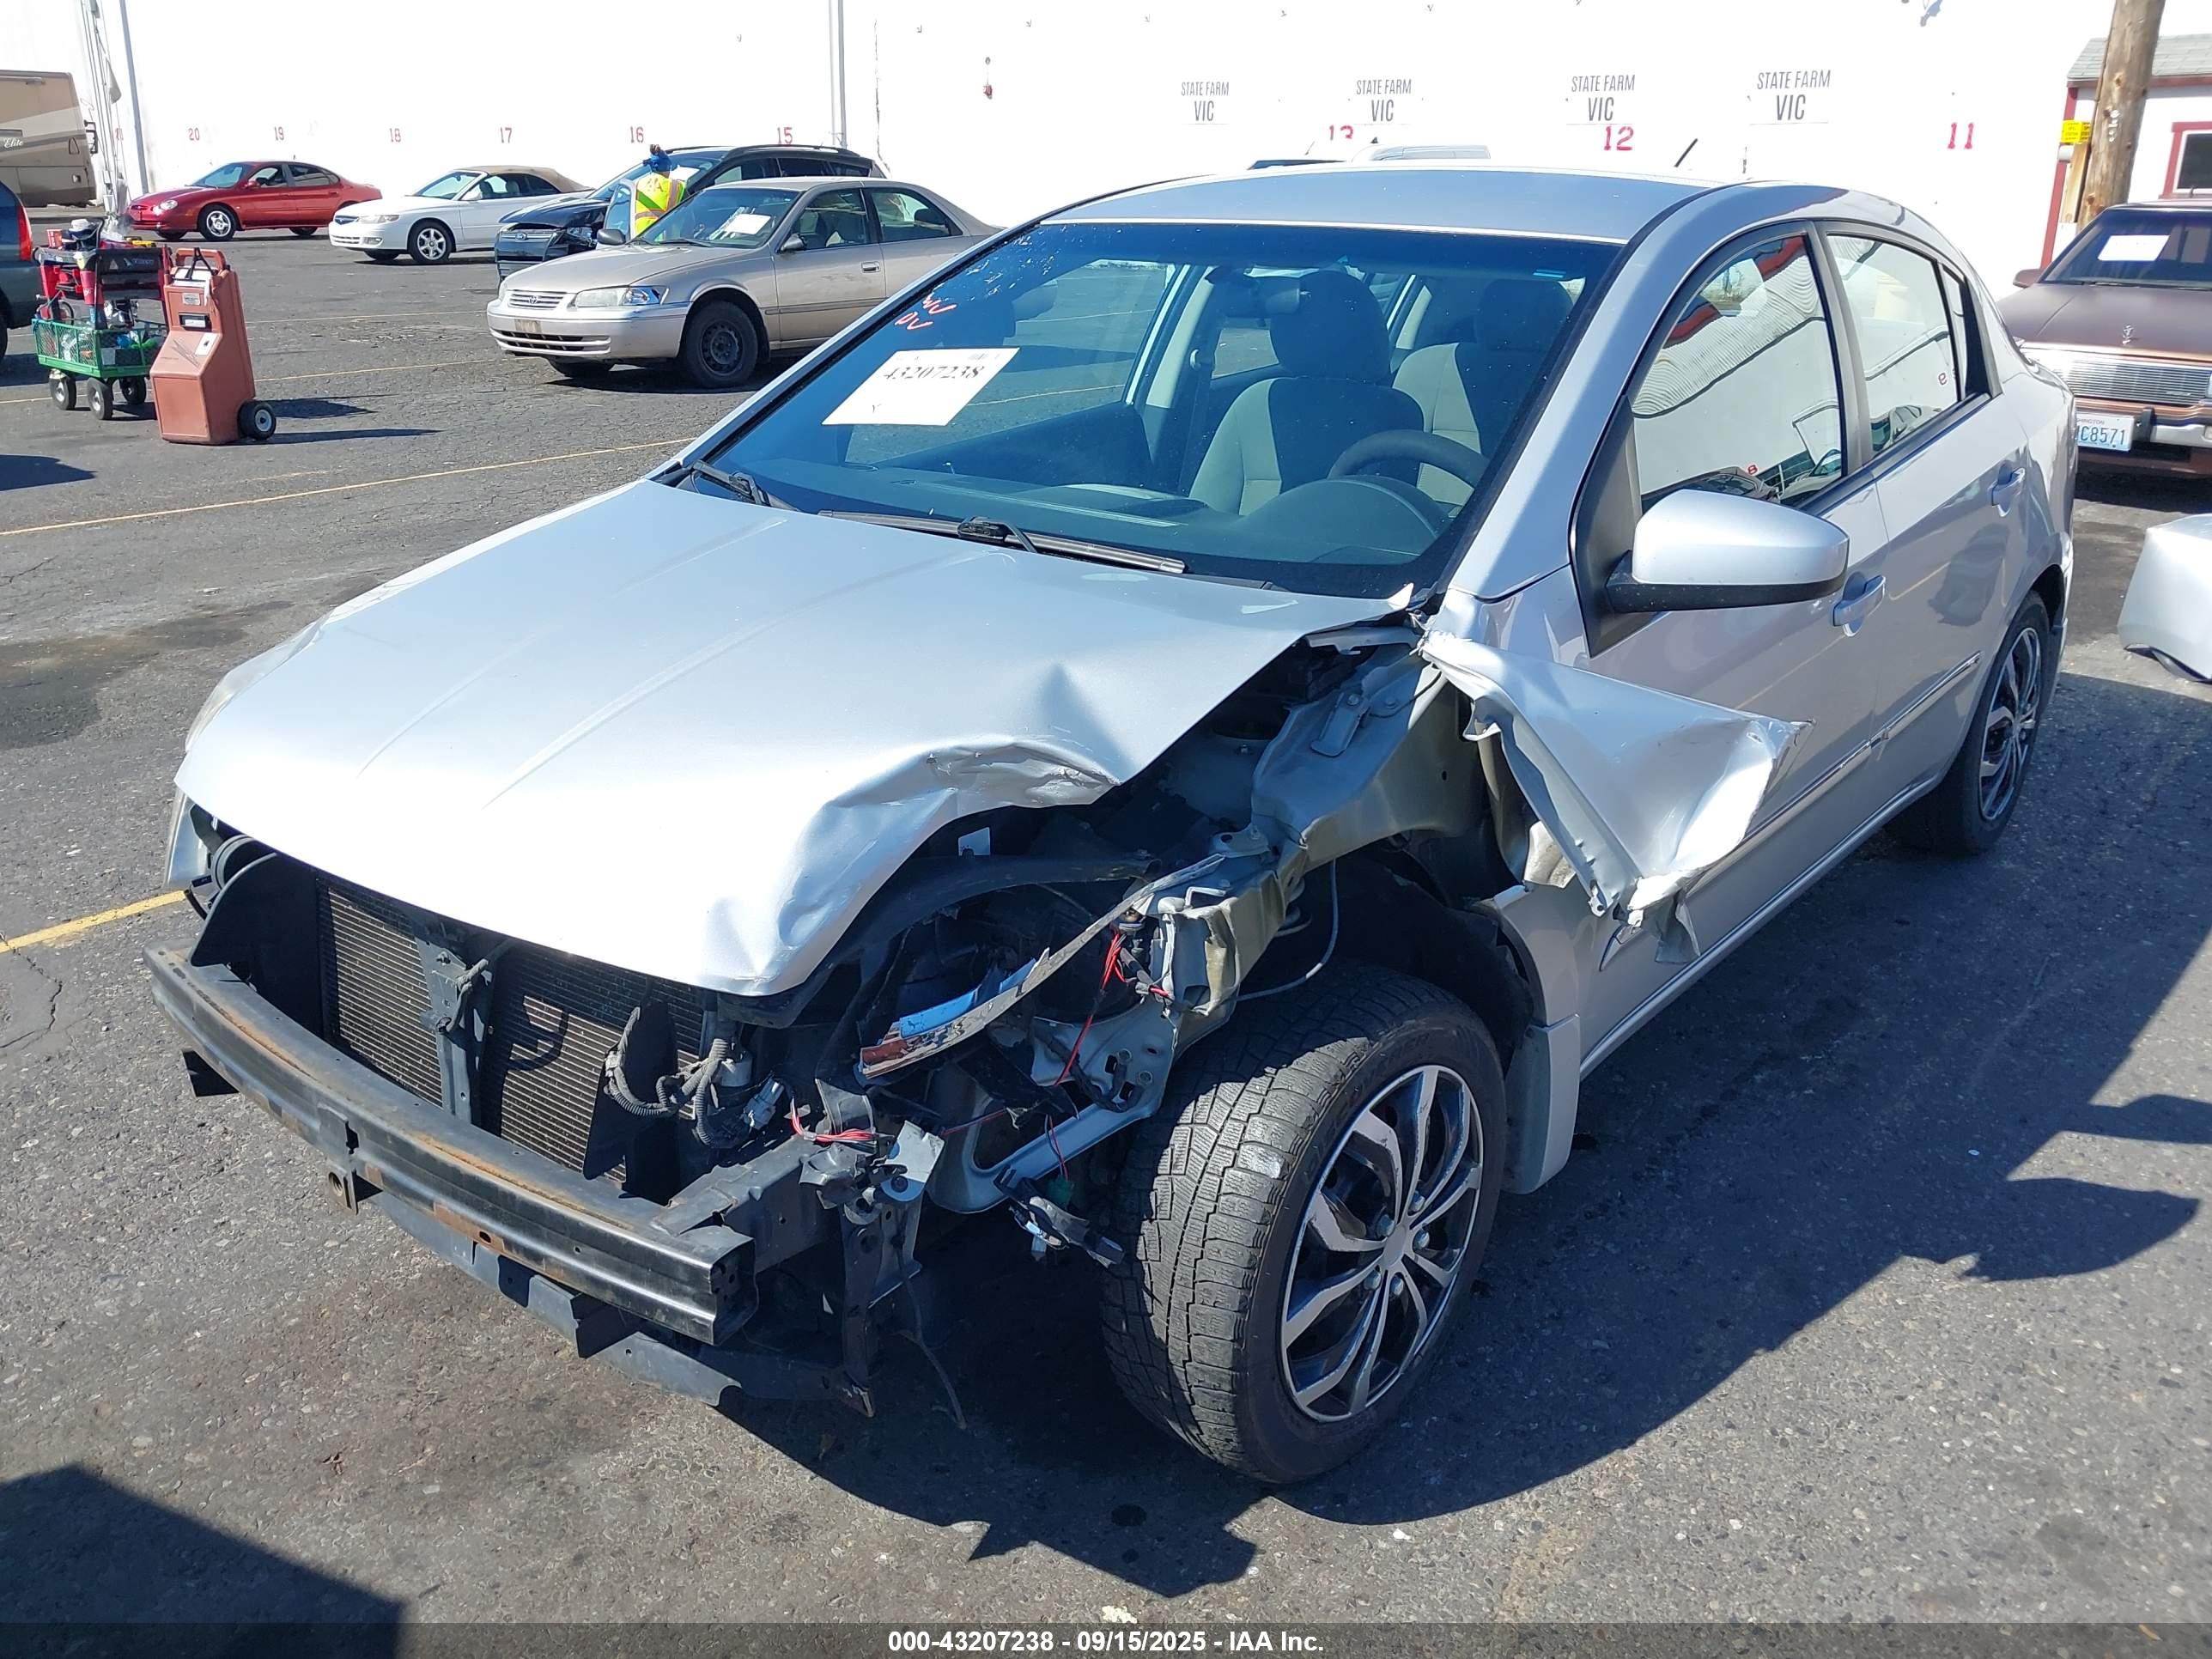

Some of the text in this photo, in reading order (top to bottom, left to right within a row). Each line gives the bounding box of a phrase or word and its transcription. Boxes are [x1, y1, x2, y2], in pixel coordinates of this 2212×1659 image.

[1181, 82, 1230, 96] STATE FARM
[1356, 78, 1412, 95] STATE FARM
[1571, 74, 1636, 93] STATE FARM
[1757, 70, 1832, 90] STATE FARM
[1194, 100, 1215, 122] VIC
[1370, 99, 1395, 122] VIC
[1588, 96, 1614, 122] VIC
[1776, 94, 1807, 121] VIC
[187, 127, 200, 141] 20
[273, 126, 285, 141] 19
[500, 126, 513, 143] 17
[629, 125, 644, 143] 16
[776, 126, 793, 144] 15
[1603, 125, 1635, 151] 12
[1947, 122, 1975, 150] 11
[883, 365, 986, 380] 43207238
